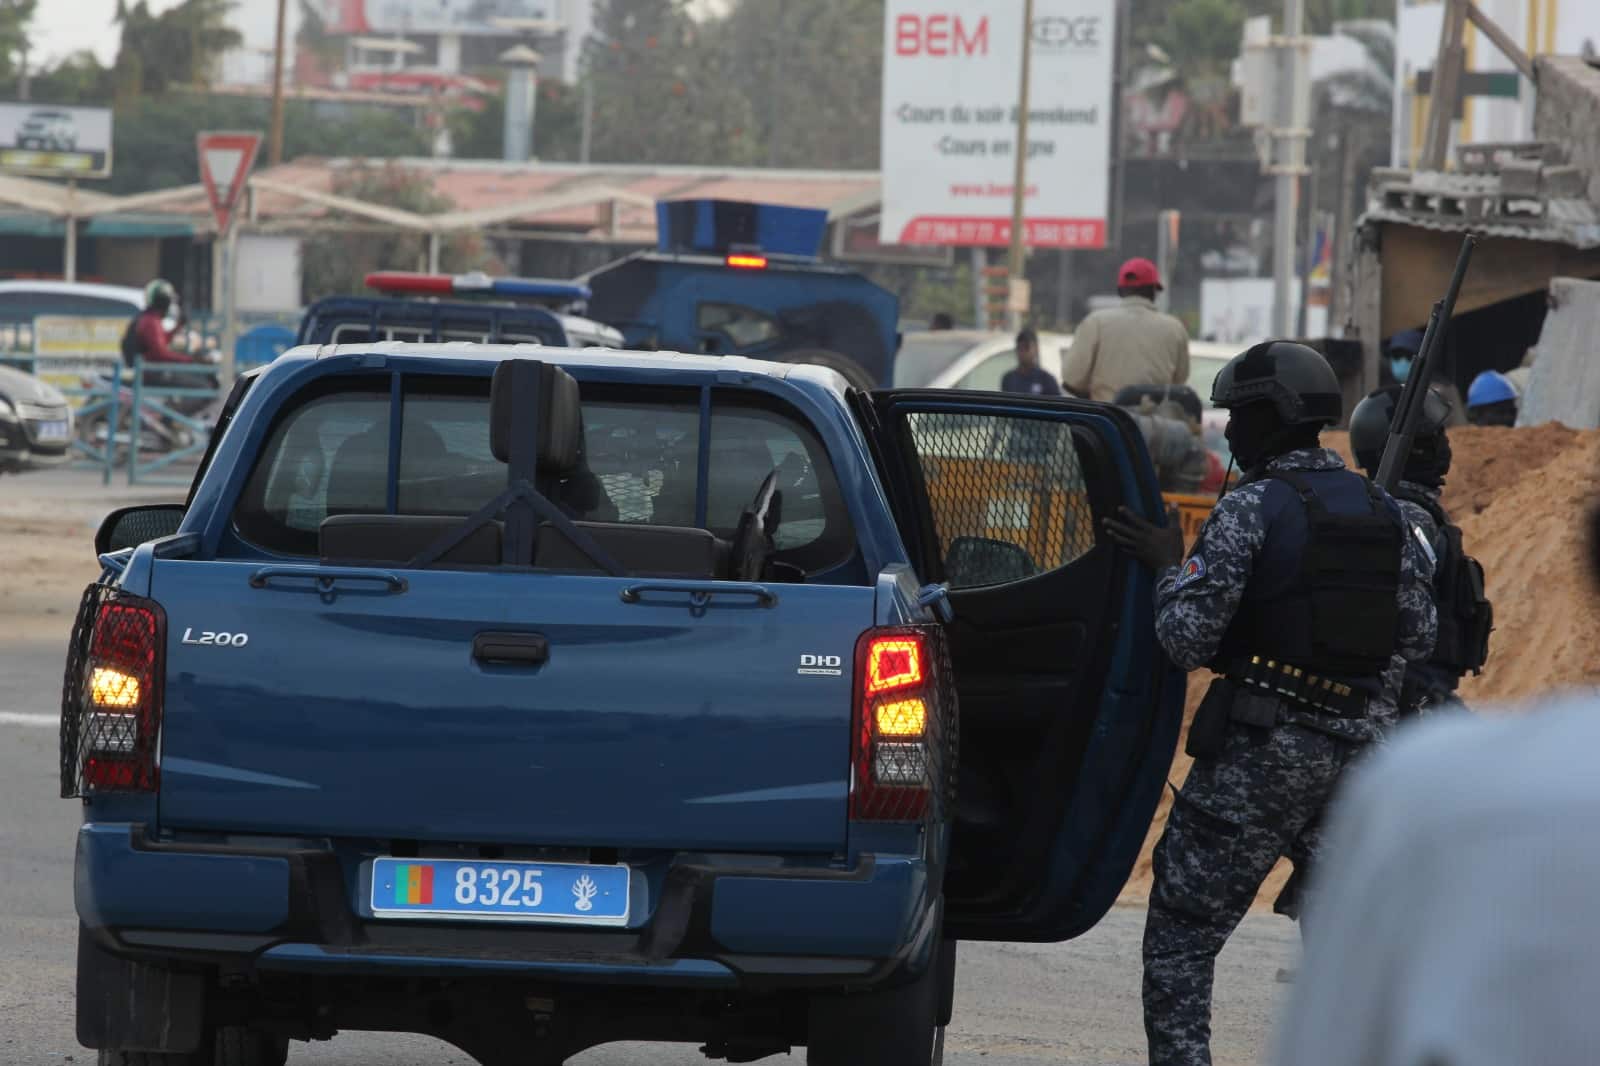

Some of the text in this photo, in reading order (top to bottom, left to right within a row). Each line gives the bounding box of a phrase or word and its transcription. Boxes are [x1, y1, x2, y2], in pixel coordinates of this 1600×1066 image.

[896, 14, 989, 57] BEM
[951, 105, 970, 123] du
[976, 106, 1004, 123] soir
[991, 141, 1010, 155] en
[182, 627, 249, 648] L200
[454, 866, 544, 907] 8325
